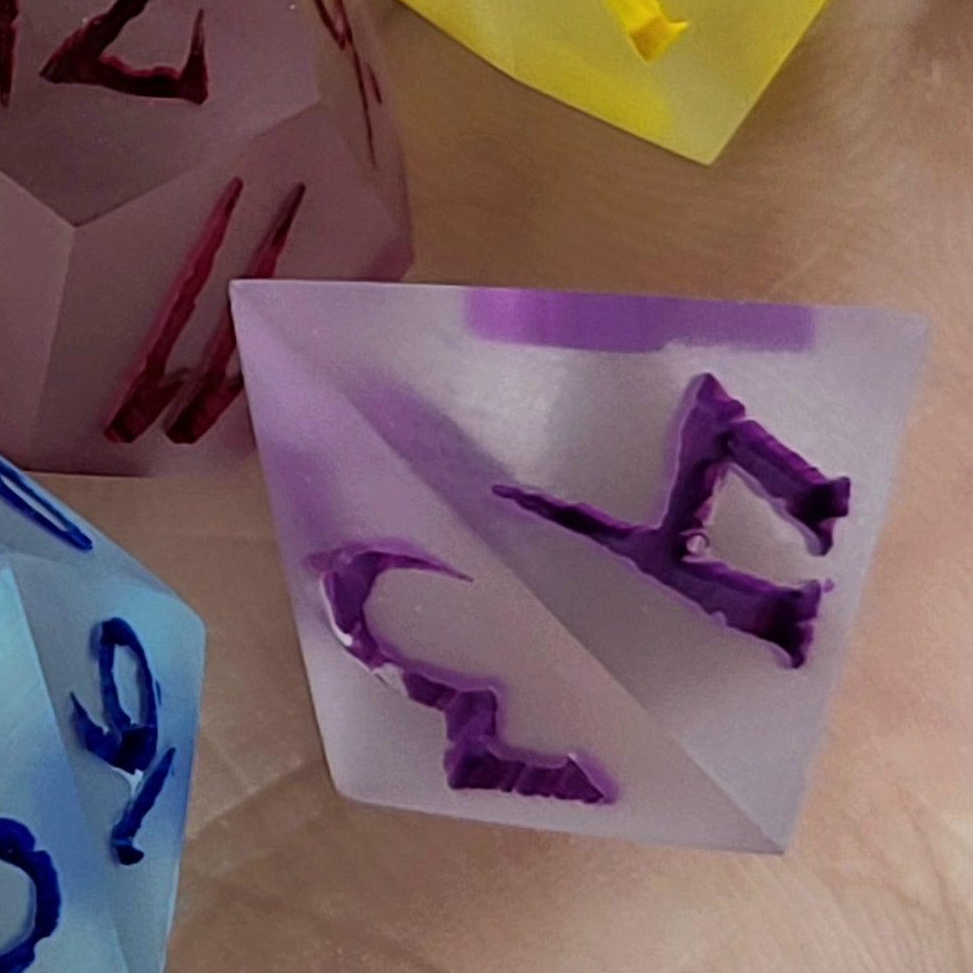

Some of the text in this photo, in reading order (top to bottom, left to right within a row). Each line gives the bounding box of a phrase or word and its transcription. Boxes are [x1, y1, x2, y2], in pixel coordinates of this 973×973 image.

[491, 372, 851, 669] 4
[69, 616, 175, 864] 16
[310, 538, 619, 804] 3
